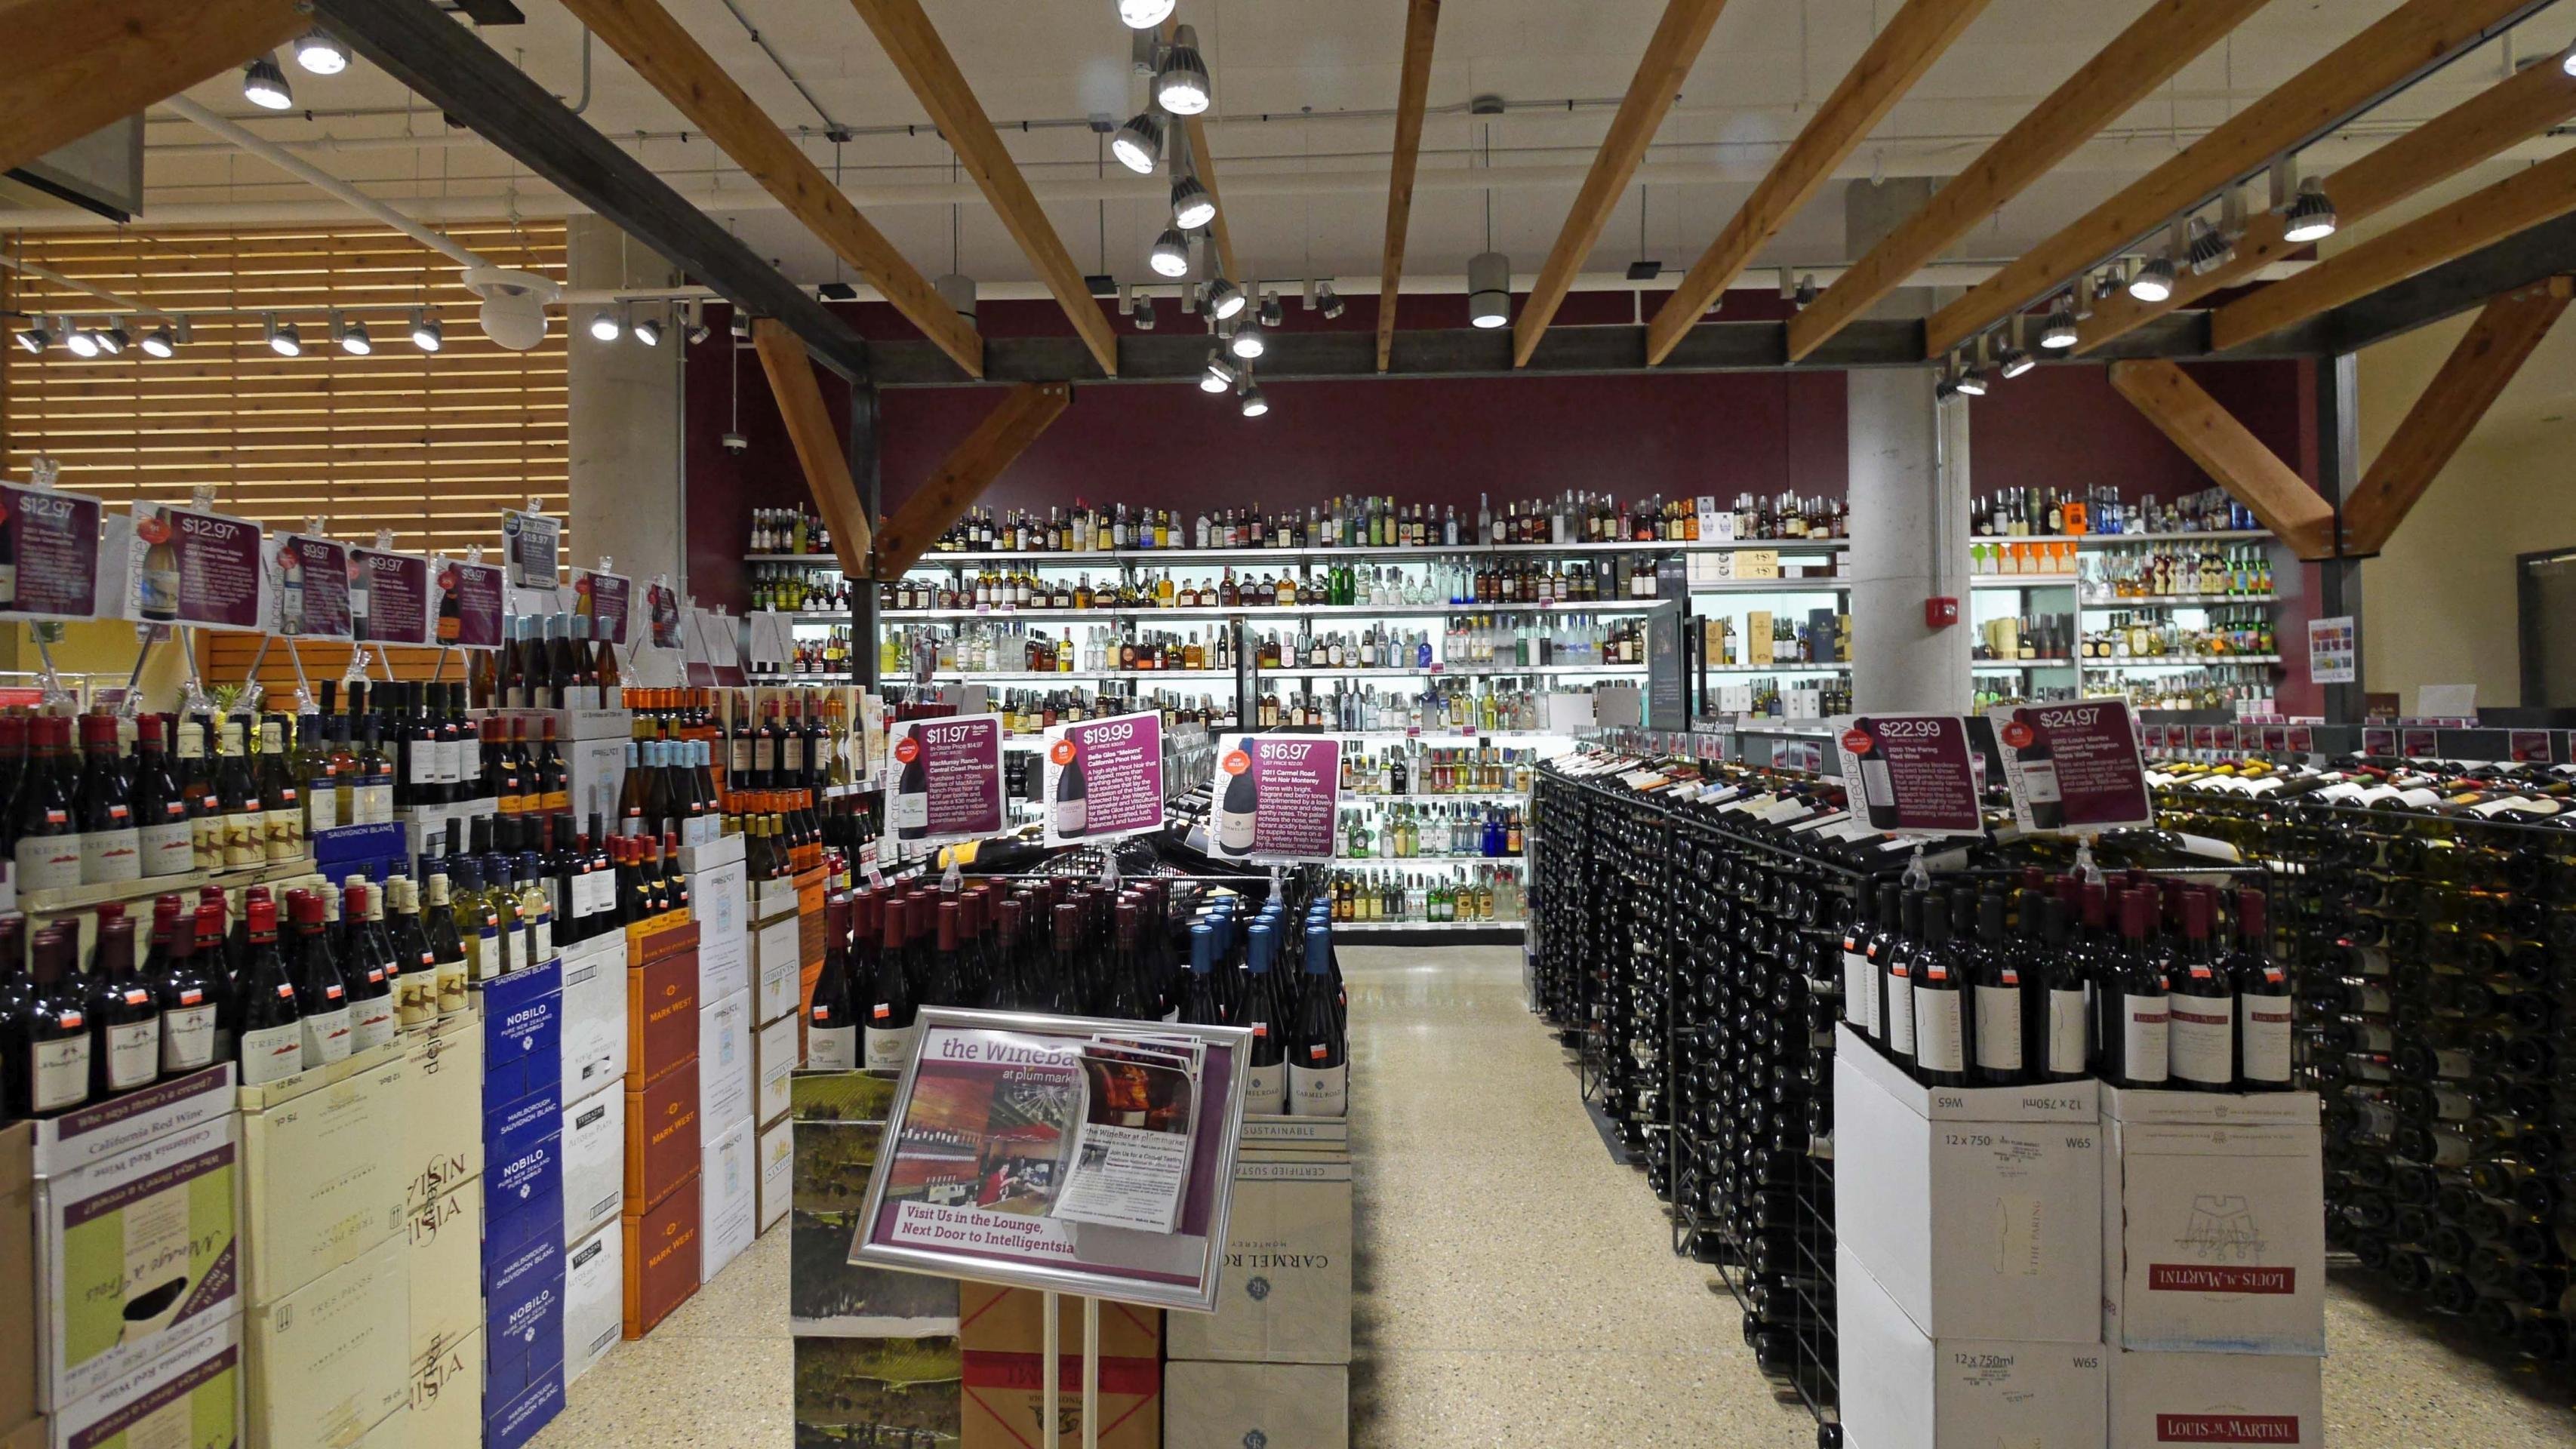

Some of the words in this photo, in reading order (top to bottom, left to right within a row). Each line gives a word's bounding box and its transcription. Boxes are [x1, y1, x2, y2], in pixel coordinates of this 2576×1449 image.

[19, 496, 75, 518] $12.97
[303, 543, 328, 558] $9.97
[369, 558, 403, 572] $9.97
[462, 569, 486, 582] $9.97
[2040, 708, 2100, 728] $24.97
[927, 725, 969, 743] $11.97
[1084, 724, 1133, 745] $19.99
[1879, 721, 1940, 737] $22.99
[1260, 743, 1311, 760] $16.97
[327, 826, 368, 839] SAUVIGNON
[495, 969, 531, 986] SAUVIGNON
[532, 962, 552, 974] BLANC
[765, 964, 794, 982] SANFORD
[506, 1004, 546, 1026] NOBILO
[650, 1008, 671, 1023] MARK
[672, 996, 692, 1011] WEST
[501, 1028, 516, 1037] PURE
[516, 1023, 528, 1032] NEW
[529, 1013, 552, 1026] ZEALAND
[525, 1023, 544, 1033] NOBILO
[382, 1044, 392, 1052] 75
[943, 1038, 978, 1060] the
[986, 1040, 1076, 1067] WineBa
[1002, 1069, 1014, 1079] at
[1015, 1066, 1043, 1082] plum
[1045, 1071, 1072, 1084] mark
[276, 1081, 286, 1091] 12
[1296, 1090, 1325, 1098] CARMEL
[78, 1113, 103, 1128] Who
[106, 1106, 129, 1120] says
[131, 1096, 165, 1111] three's
[177, 1076, 214, 1096] crowd?
[508, 1098, 551, 1122] MARLBOROUGH
[1938, 1097, 1963, 1108] W65
[2023, 1098, 2056, 1109] 750ml
[2070, 1100, 2082, 1109] 12
[500, 1114, 536, 1134] SAUVIGNON
[537, 1103, 557, 1117] BLANC
[578, 1106, 604, 1124] TERRAZAS
[88, 1128, 149, 1155] California
[152, 1117, 174, 1133] Red
[176, 1109, 204, 1124] Wine
[652, 1125, 675, 1145] MARK
[675, 1111, 694, 1130] WEST
[1100, 1129, 1131, 1140] WineBar
[1243, 1127, 1315, 1135] SUSTAINABLE
[155, 1130, 210, 1155] California
[1946, 1135, 1958, 1144] 12
[1971, 1136, 1993, 1146] 750
[2066, 1137, 2091, 1149] W65
[130, 1151, 152, 1166] Red
[503, 1149, 543, 1177] NOBILO
[94, 1161, 126, 1177] Wine
[1272, 1167, 1325, 1176] CERTIFIED
[907, 1205, 934, 1220] Visit
[937, 1210, 953, 1222] Us
[954, 1212, 968, 1224] in
[971, 1214, 991, 1227] the
[993, 1216, 1044, 1234] Lounge,
[902, 1223, 931, 1236] Next
[934, 1226, 966, 1241] Door
[969, 1232, 982, 1242] to
[985, 1232, 1075, 1254] Intelligentsia
[574, 1241, 601, 1263] TERRAZAS
[648, 1247, 672, 1269] MARK
[672, 1229, 694, 1250] WEST
[1249, 1254, 1328, 1268] CARMEL
[2159, 1270, 2224, 1287] MARTINI
[2242, 1272, 2285, 1289] LOUIS
[509, 1290, 549, 1324] NOBILO
[1955, 1353, 1967, 1364] 12
[1980, 1355, 2014, 1366] 750ml
[2073, 1358, 2097, 1368] W65
[2168, 1420, 2209, 1436] LOUIS
[2229, 1420, 2288, 1438] MARTINI
